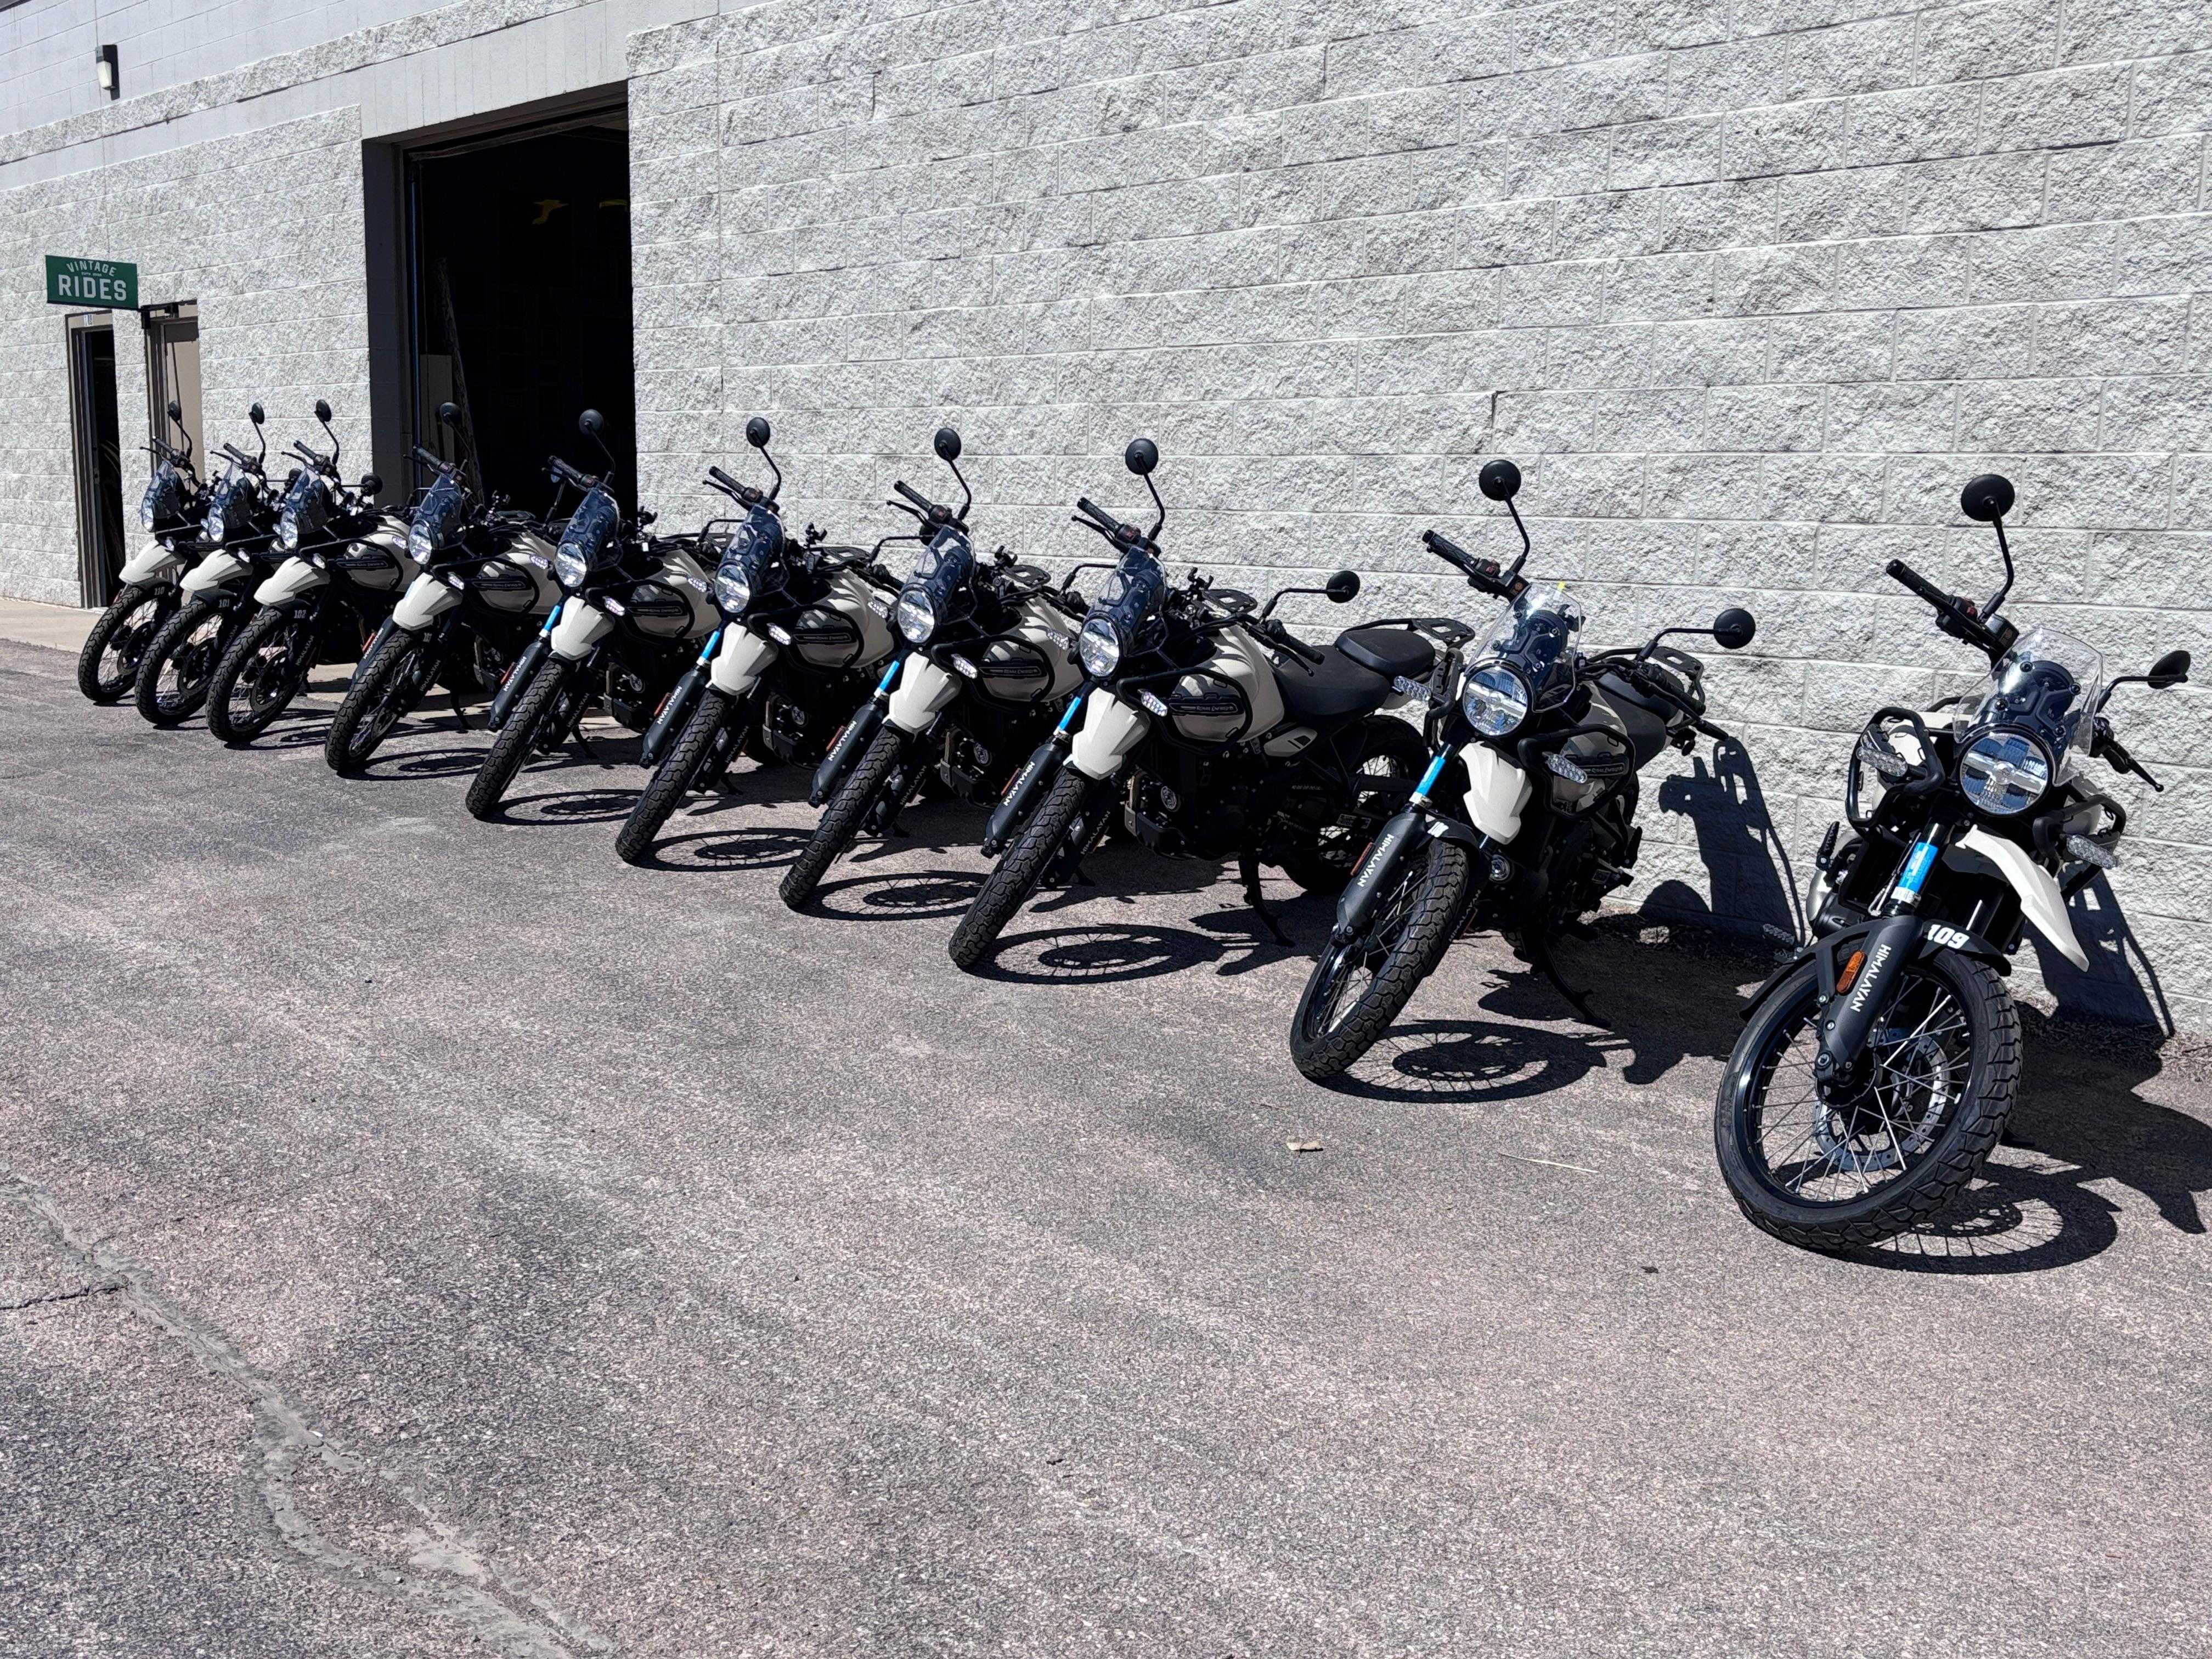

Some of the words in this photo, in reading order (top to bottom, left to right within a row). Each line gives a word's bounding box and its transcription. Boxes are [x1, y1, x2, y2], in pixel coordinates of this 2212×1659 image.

[58, 274, 127, 301] RIDES
[66, 261, 117, 276] VINTAGE
[657, 686, 682, 724] HIMALAYAN
[827, 720, 857, 761] HIMALAYAN
[1003, 761, 1035, 806] HIMALAYAN
[1357, 833, 1395, 887] HIMALAYAN
[1927, 924, 1970, 950] 109
[1850, 944, 1892, 1012] HIMALAYAN
